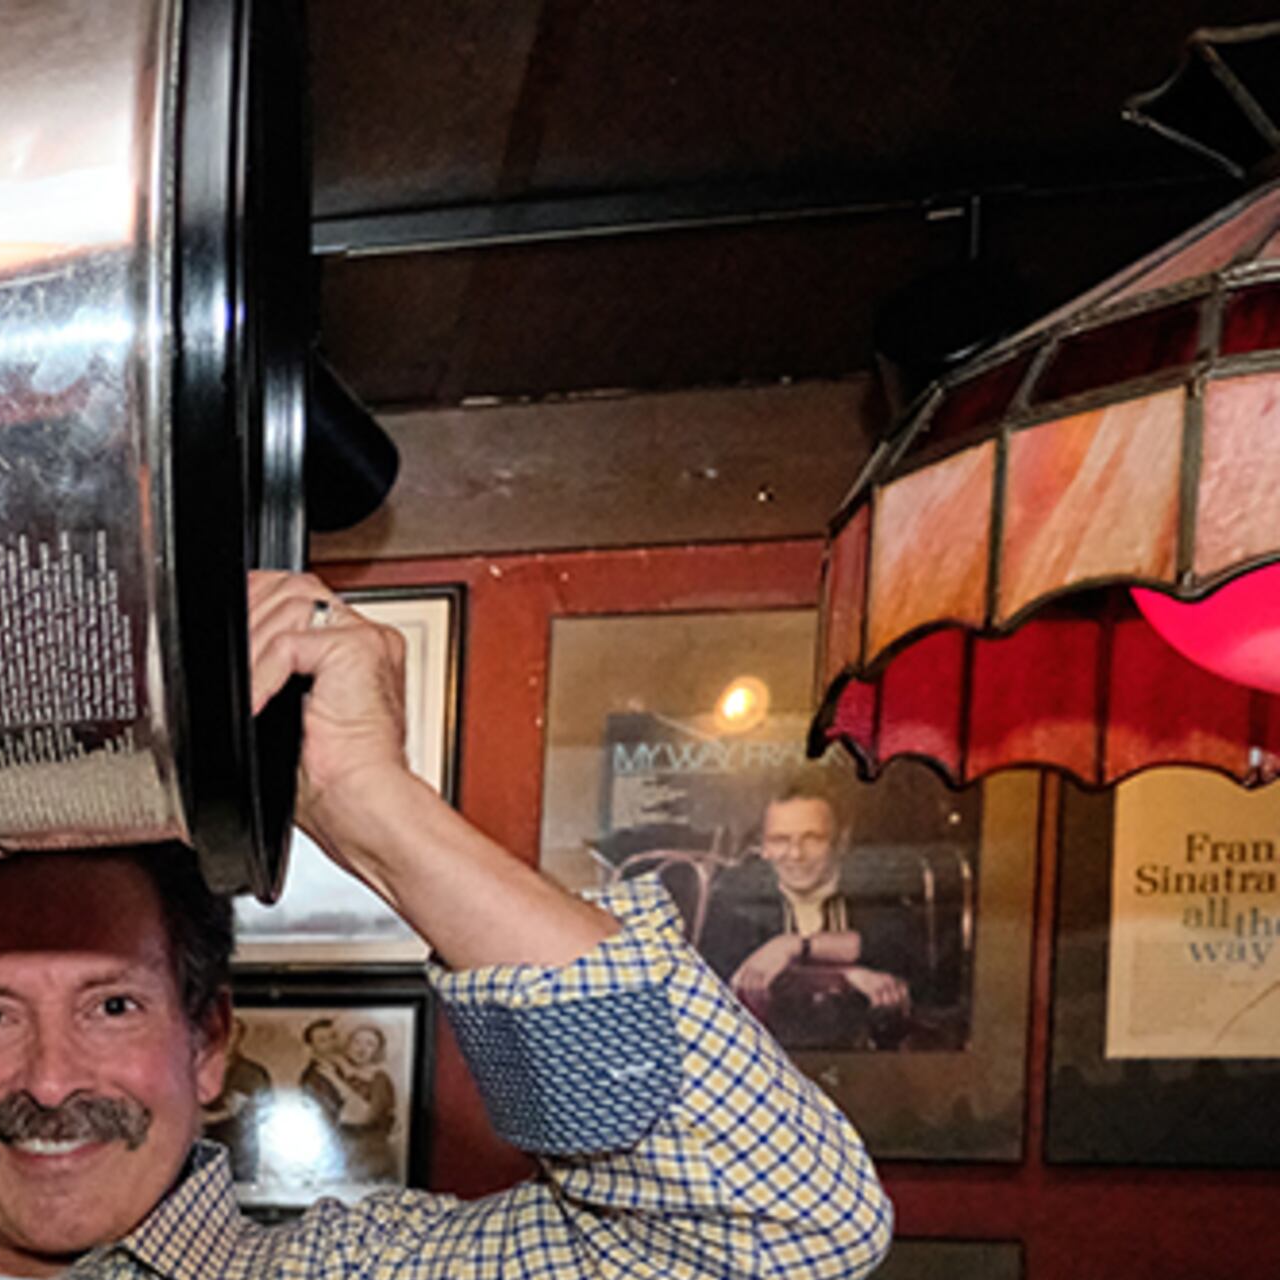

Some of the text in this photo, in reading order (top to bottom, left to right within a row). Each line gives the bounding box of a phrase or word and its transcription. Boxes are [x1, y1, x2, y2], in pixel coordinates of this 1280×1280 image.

[613, 742, 661, 770] MY
[663, 742, 737, 769] WAY
[1186, 832, 1275, 863] Fran
[1134, 864, 1277, 896] Sinatra
[1183, 897, 1230, 928] all
[1189, 942, 1272, 971] way
